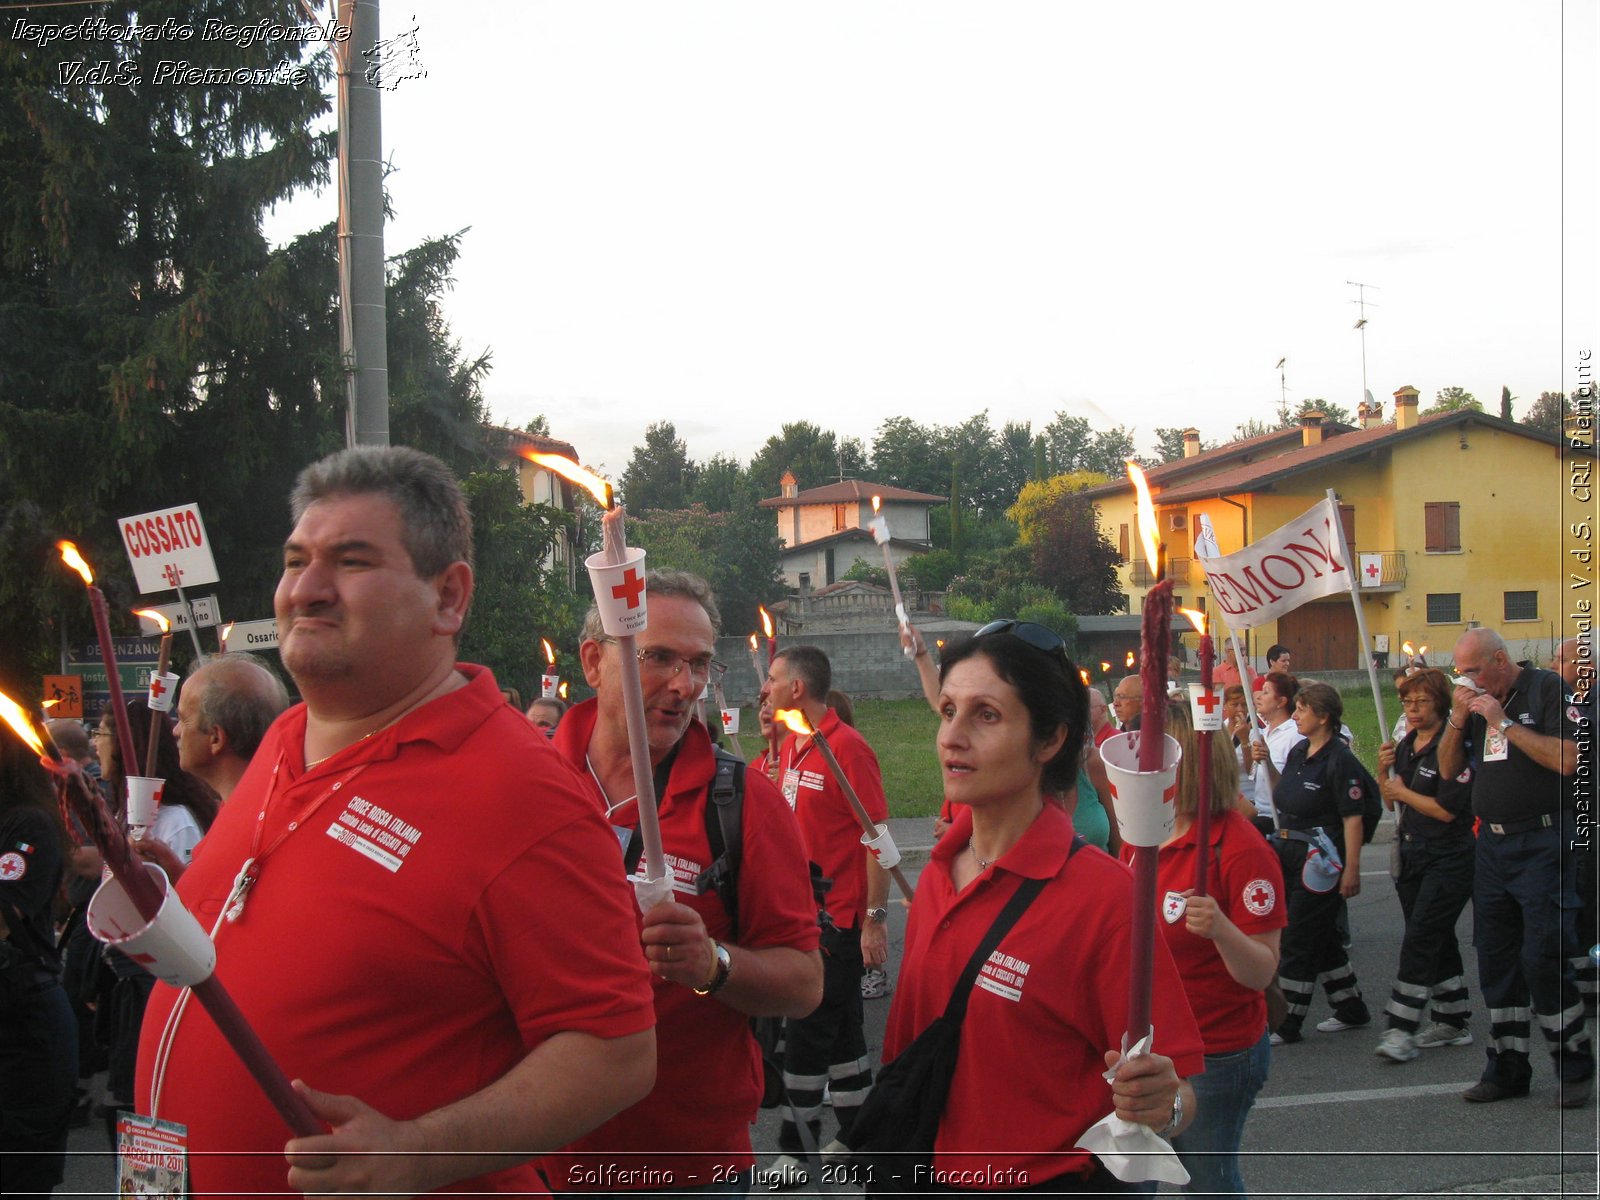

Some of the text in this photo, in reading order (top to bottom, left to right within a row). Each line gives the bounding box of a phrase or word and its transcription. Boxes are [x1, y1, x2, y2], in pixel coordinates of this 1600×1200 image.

[125, 510, 202, 558] COSSATO
[177, 612, 209, 624] Maino
[87, 643, 160, 656] DEENZANO
[347, 795, 422, 845] CROCE ROSSA ITALIANA
[376, 830, 402, 851] COSSATO
[1002, 955, 1030, 976] ITALIANA
[166, 1156, 184, 1173] 2011
